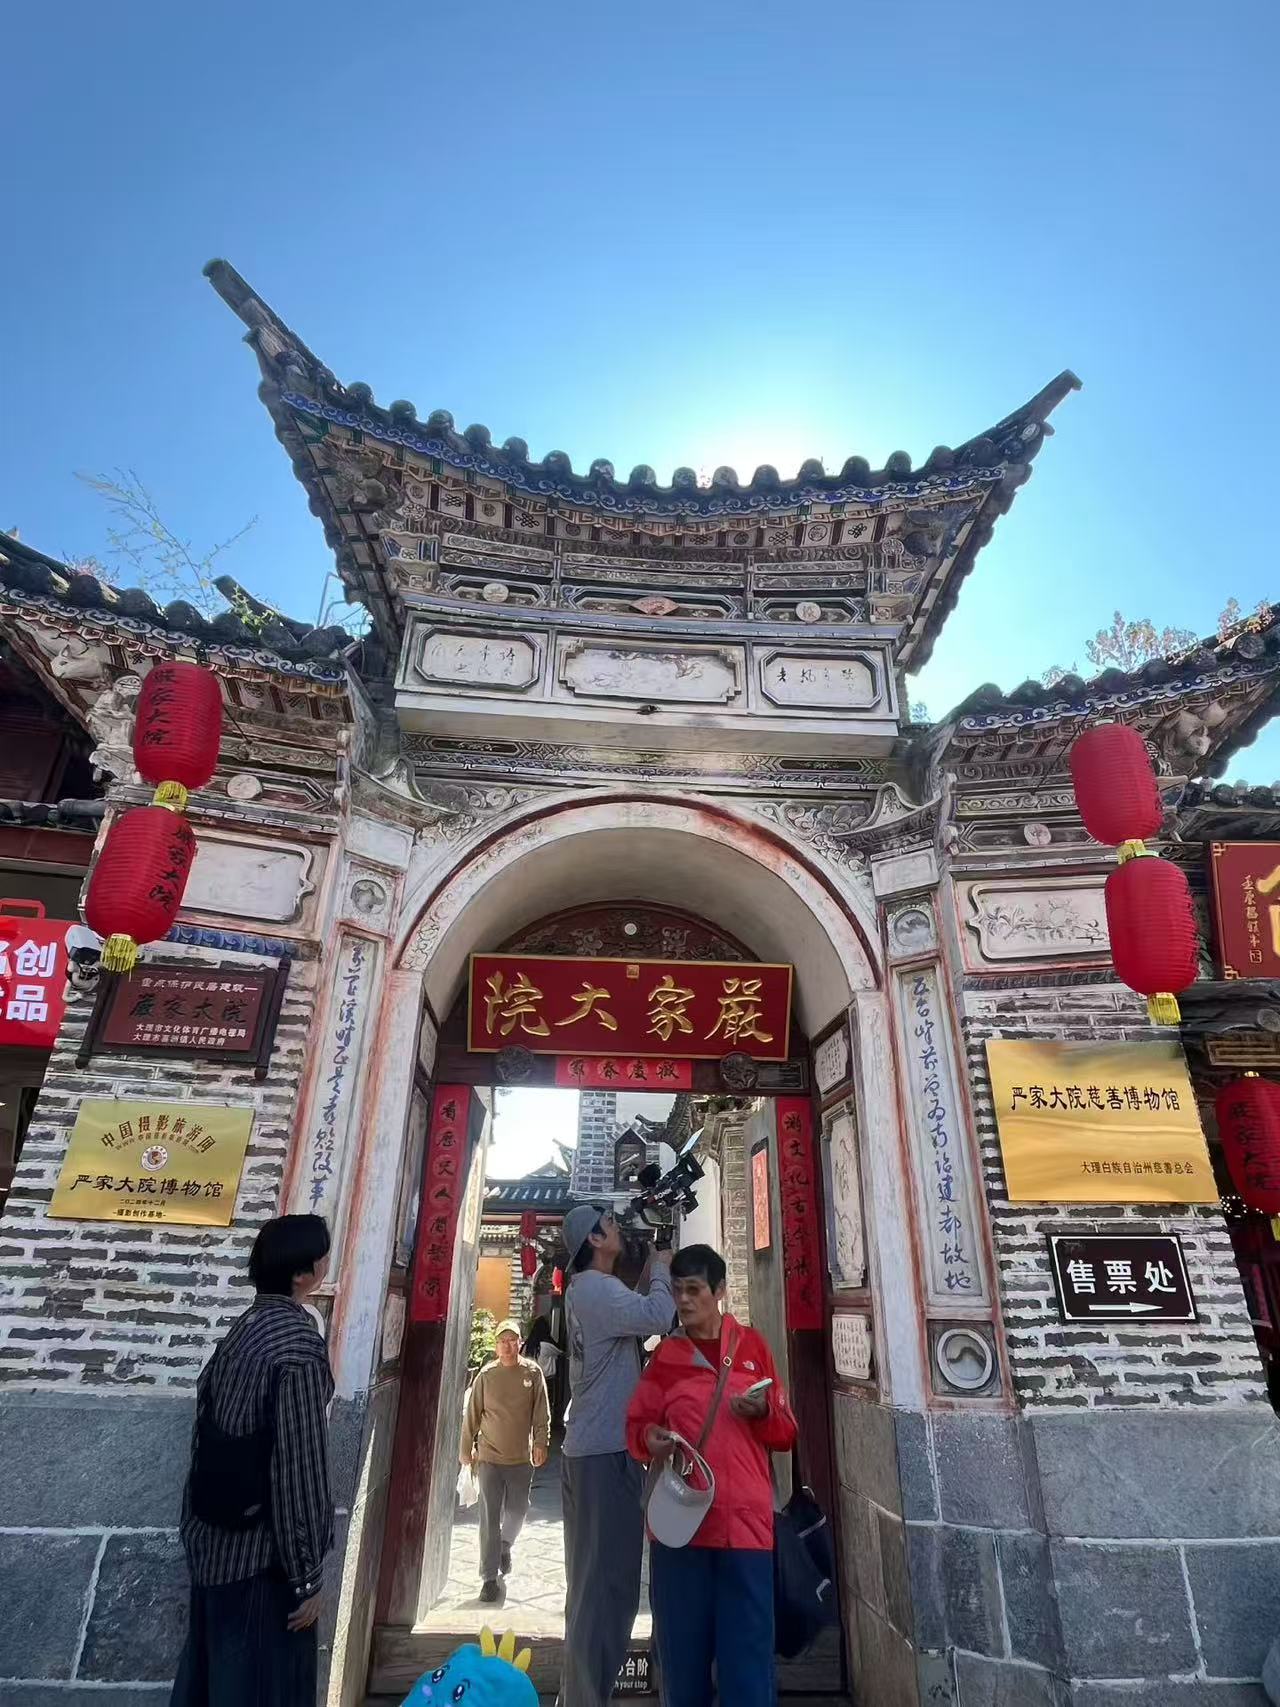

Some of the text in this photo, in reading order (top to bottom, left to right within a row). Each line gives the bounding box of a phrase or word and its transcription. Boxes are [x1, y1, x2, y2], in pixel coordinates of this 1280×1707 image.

[0, 985, 48, 1022] 品
[1011, 1085, 1181, 1111] 严家大院慈善博物馆
[101, 1114, 216, 1154] 中国摄影旅游网
[1081, 1161, 1194, 1175] 大理白族自治州慈善总会
[69, 1174, 224, 1198] 严家大院博物馆
[1066, 1260, 1177, 1294] 售票处
